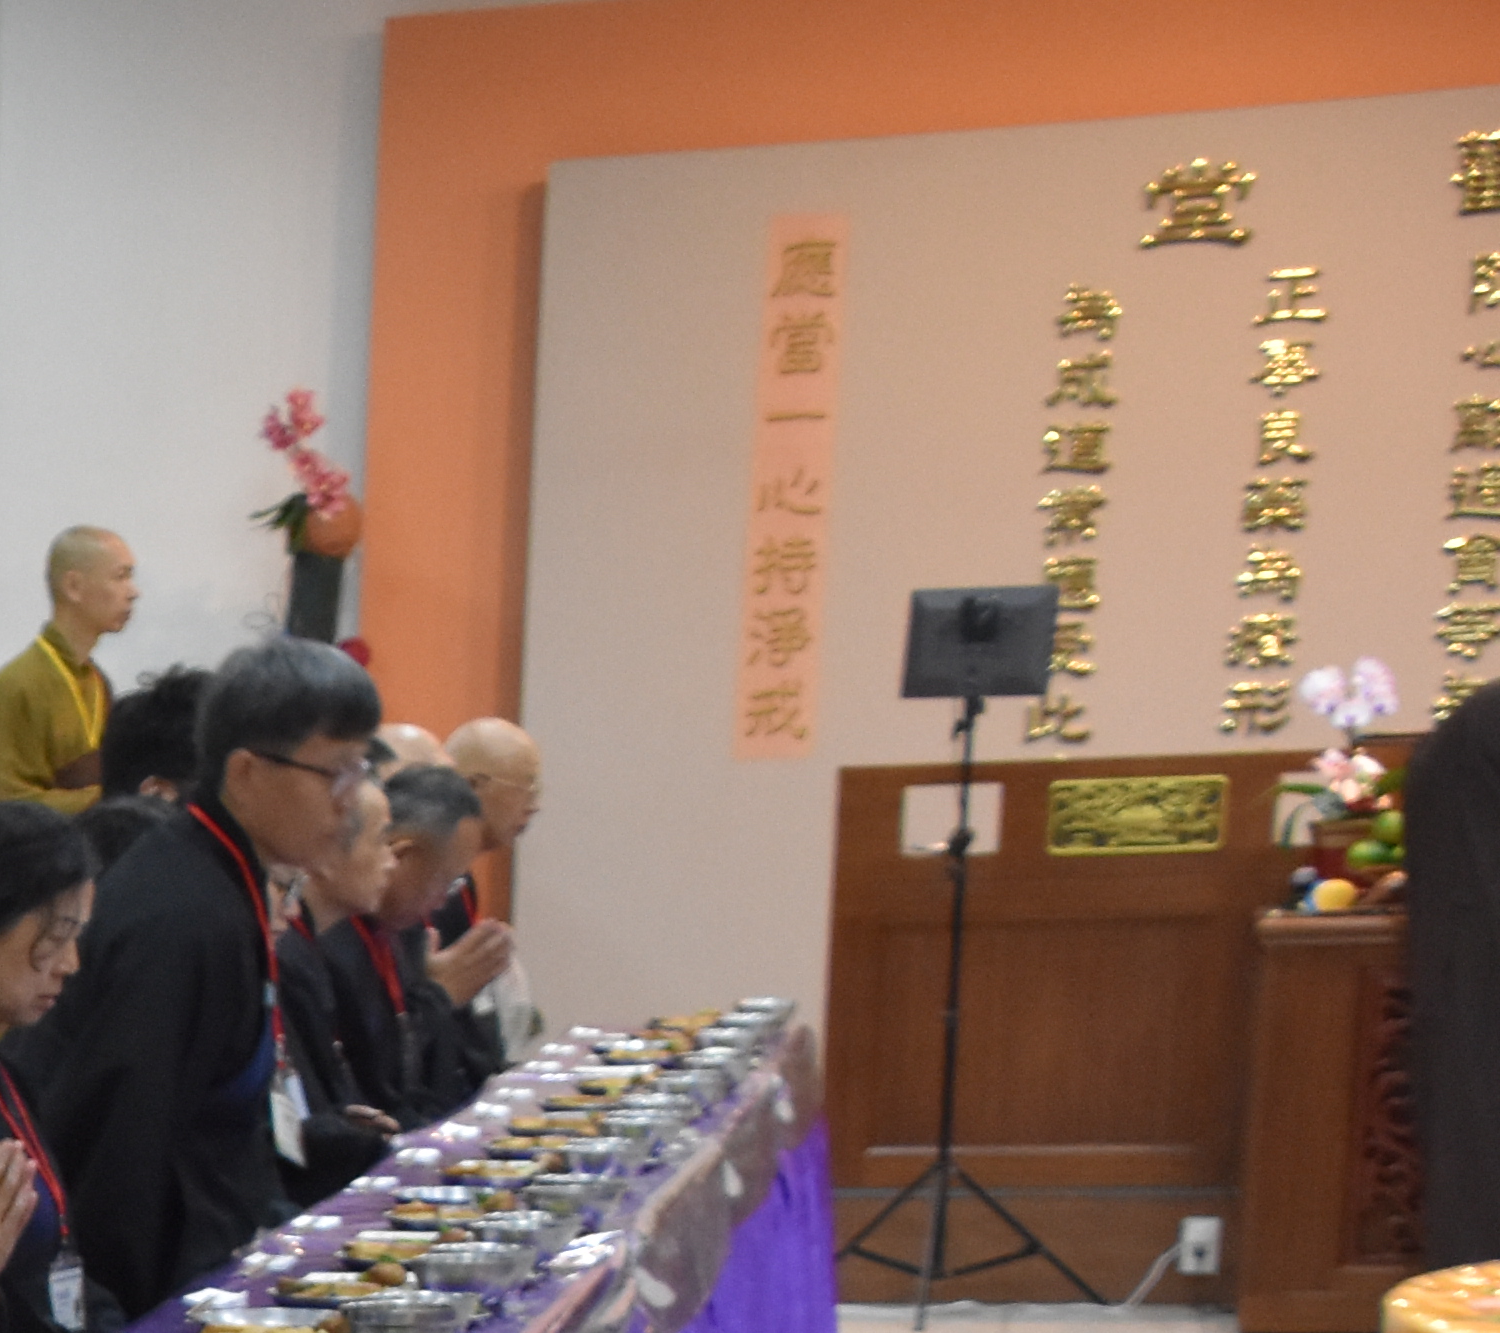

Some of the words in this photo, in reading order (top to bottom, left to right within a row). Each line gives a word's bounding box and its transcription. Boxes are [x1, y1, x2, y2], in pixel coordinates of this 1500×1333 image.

[1139, 157, 1259, 249] 堂
[743, 238, 840, 742] 應當一心持淨戒
